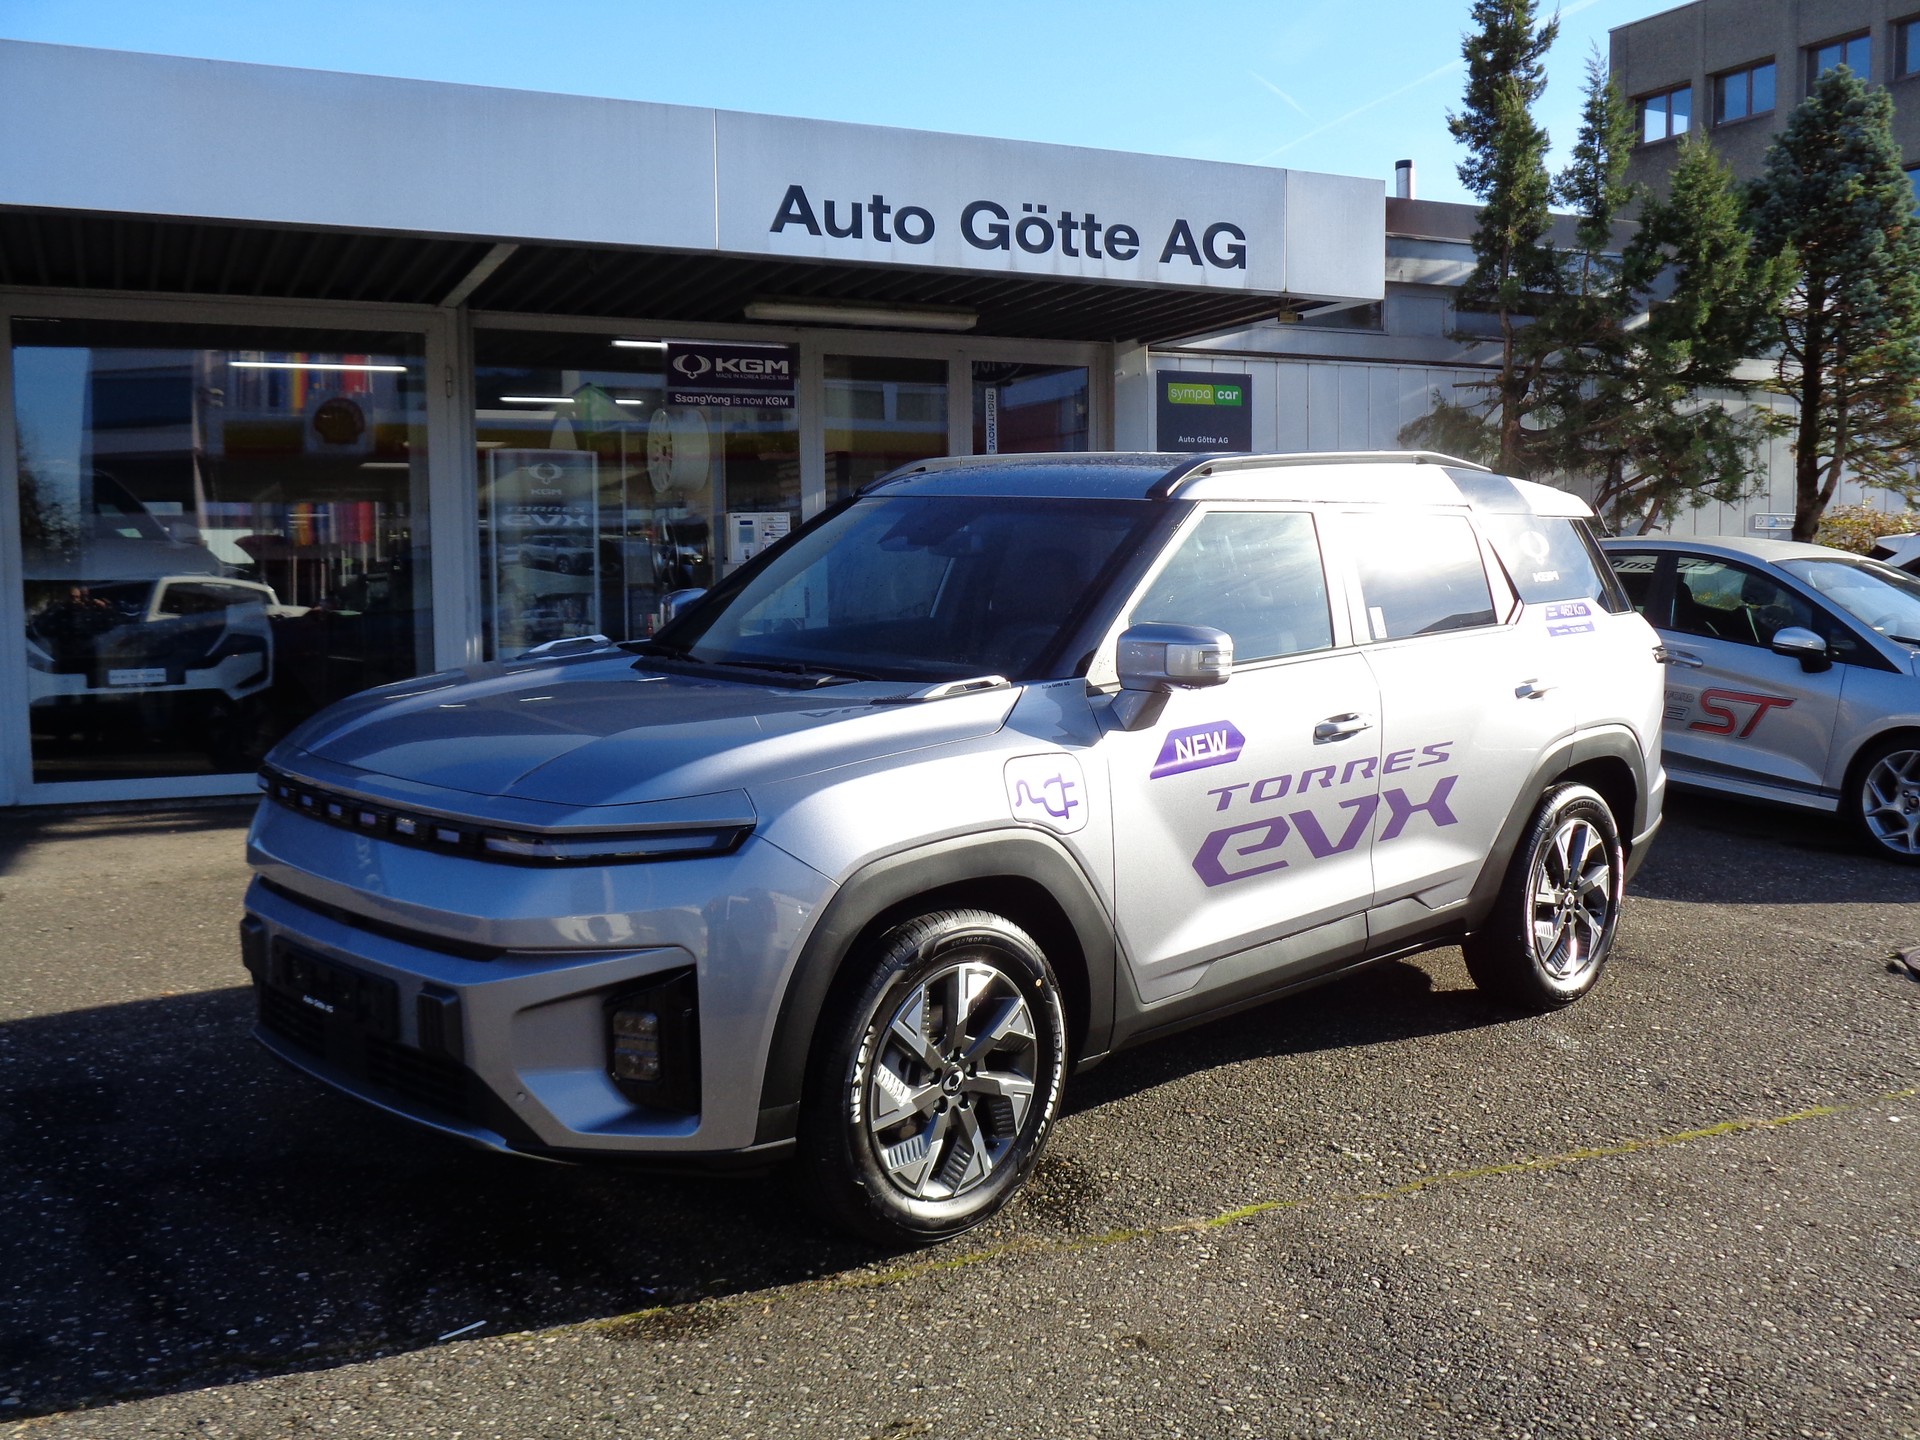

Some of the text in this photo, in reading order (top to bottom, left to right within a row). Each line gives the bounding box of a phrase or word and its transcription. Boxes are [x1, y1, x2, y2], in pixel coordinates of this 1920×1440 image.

[769, 184, 1247, 270] Auto Götte AG
[715, 357, 789, 375] KGM
[674, 393, 789, 406] SsangYong is now KGM
[1170, 388, 1239, 402] sympa car
[1178, 435, 1229, 444] Auto Götte AG
[1688, 687, 1797, 740] ST
[1174, 729, 1228, 764] NEW
[1207, 740, 1454, 812] TORRES
[849, 1025, 877, 1124] NEXEN
